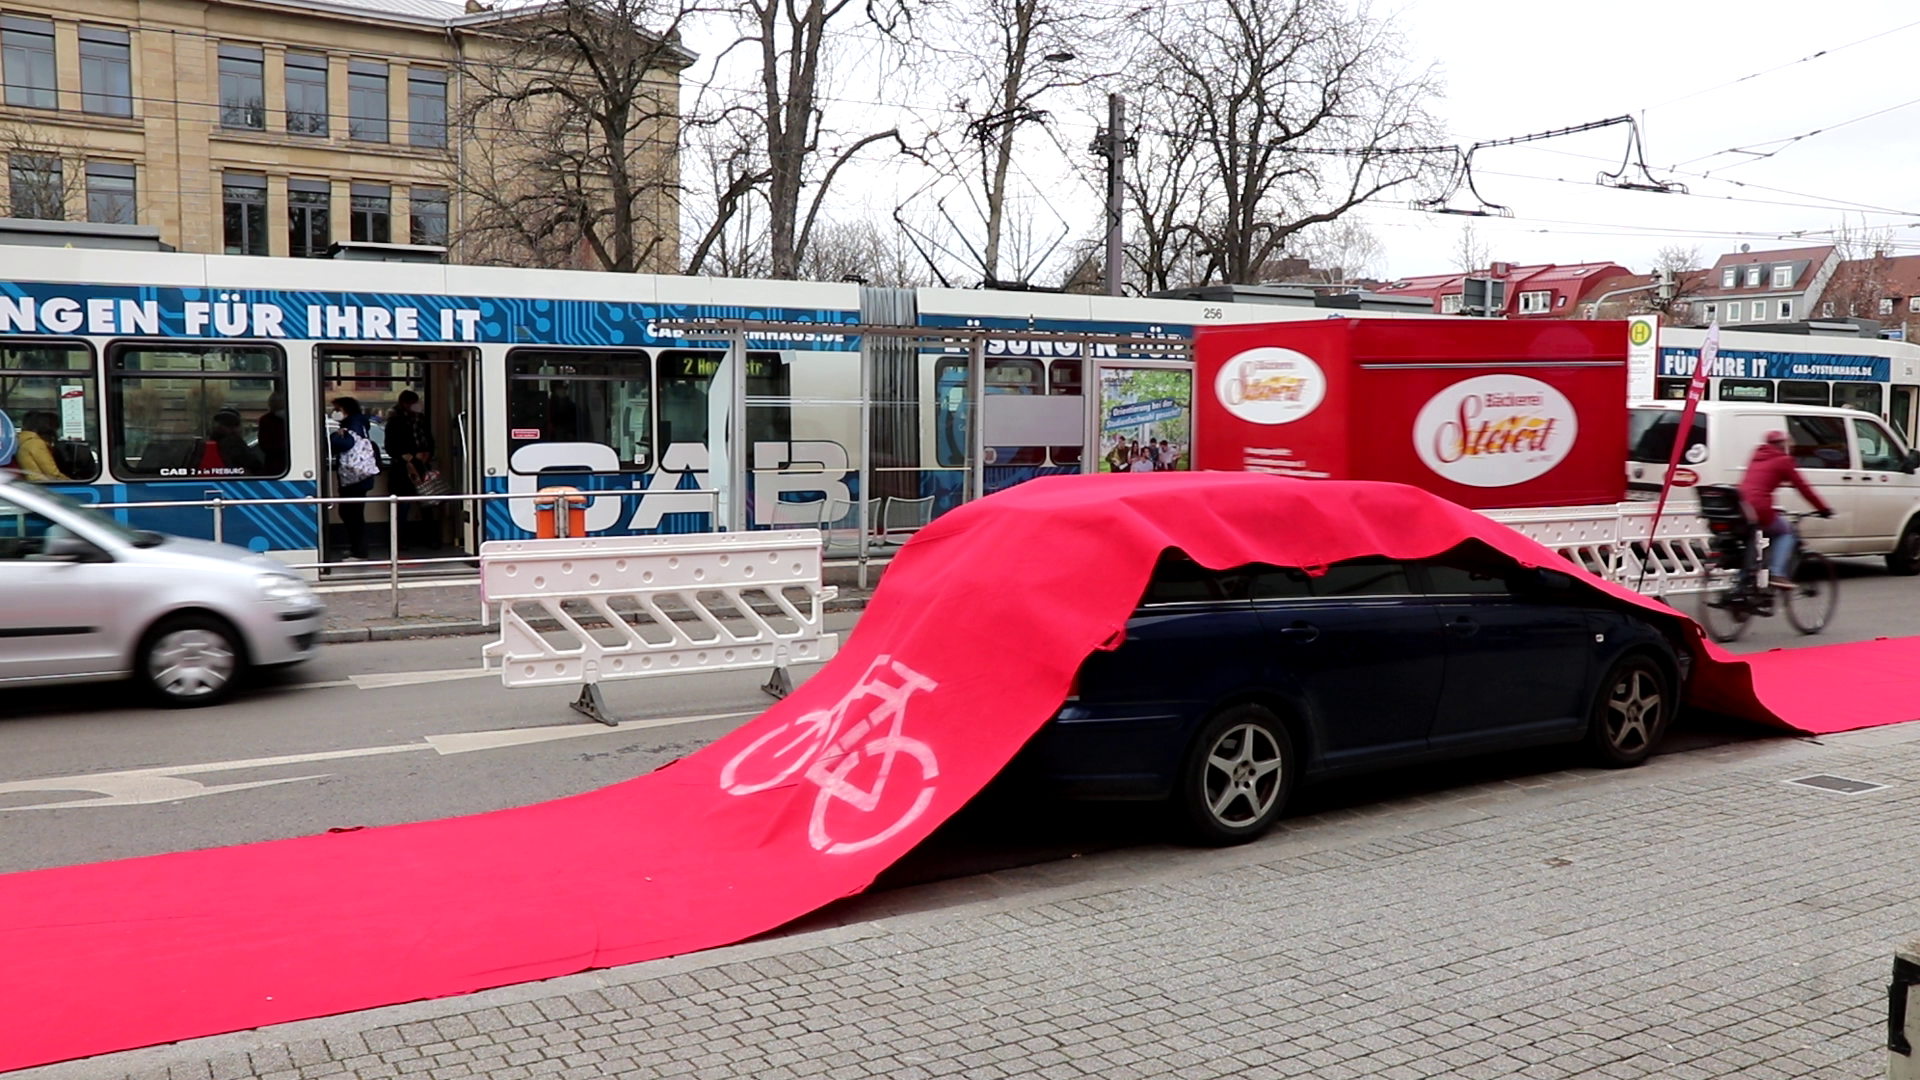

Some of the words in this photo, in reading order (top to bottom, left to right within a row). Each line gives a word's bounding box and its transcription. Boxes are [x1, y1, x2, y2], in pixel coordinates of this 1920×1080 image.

[0, 297, 159, 334] NGEN
[185, 293, 286, 337] FÜR
[307, 304, 419, 339] IHRE
[440, 308, 480, 341] IT
[1203, 307, 1223, 319] 256
[683, 357, 694, 375] 2
[698, 358, 766, 376] Horstr.
[1664, 350, 1699, 376] FÜR
[1706, 356, 1745, 377] HRE
[1752, 358, 1768, 378] IT
[1792, 364, 1872, 376] CAB-SYSTEMHAUS.DE
[160, 468, 187, 476] CAB
[211, 467, 245, 475] FREIBURG
[508, 440, 851, 532] CAB
